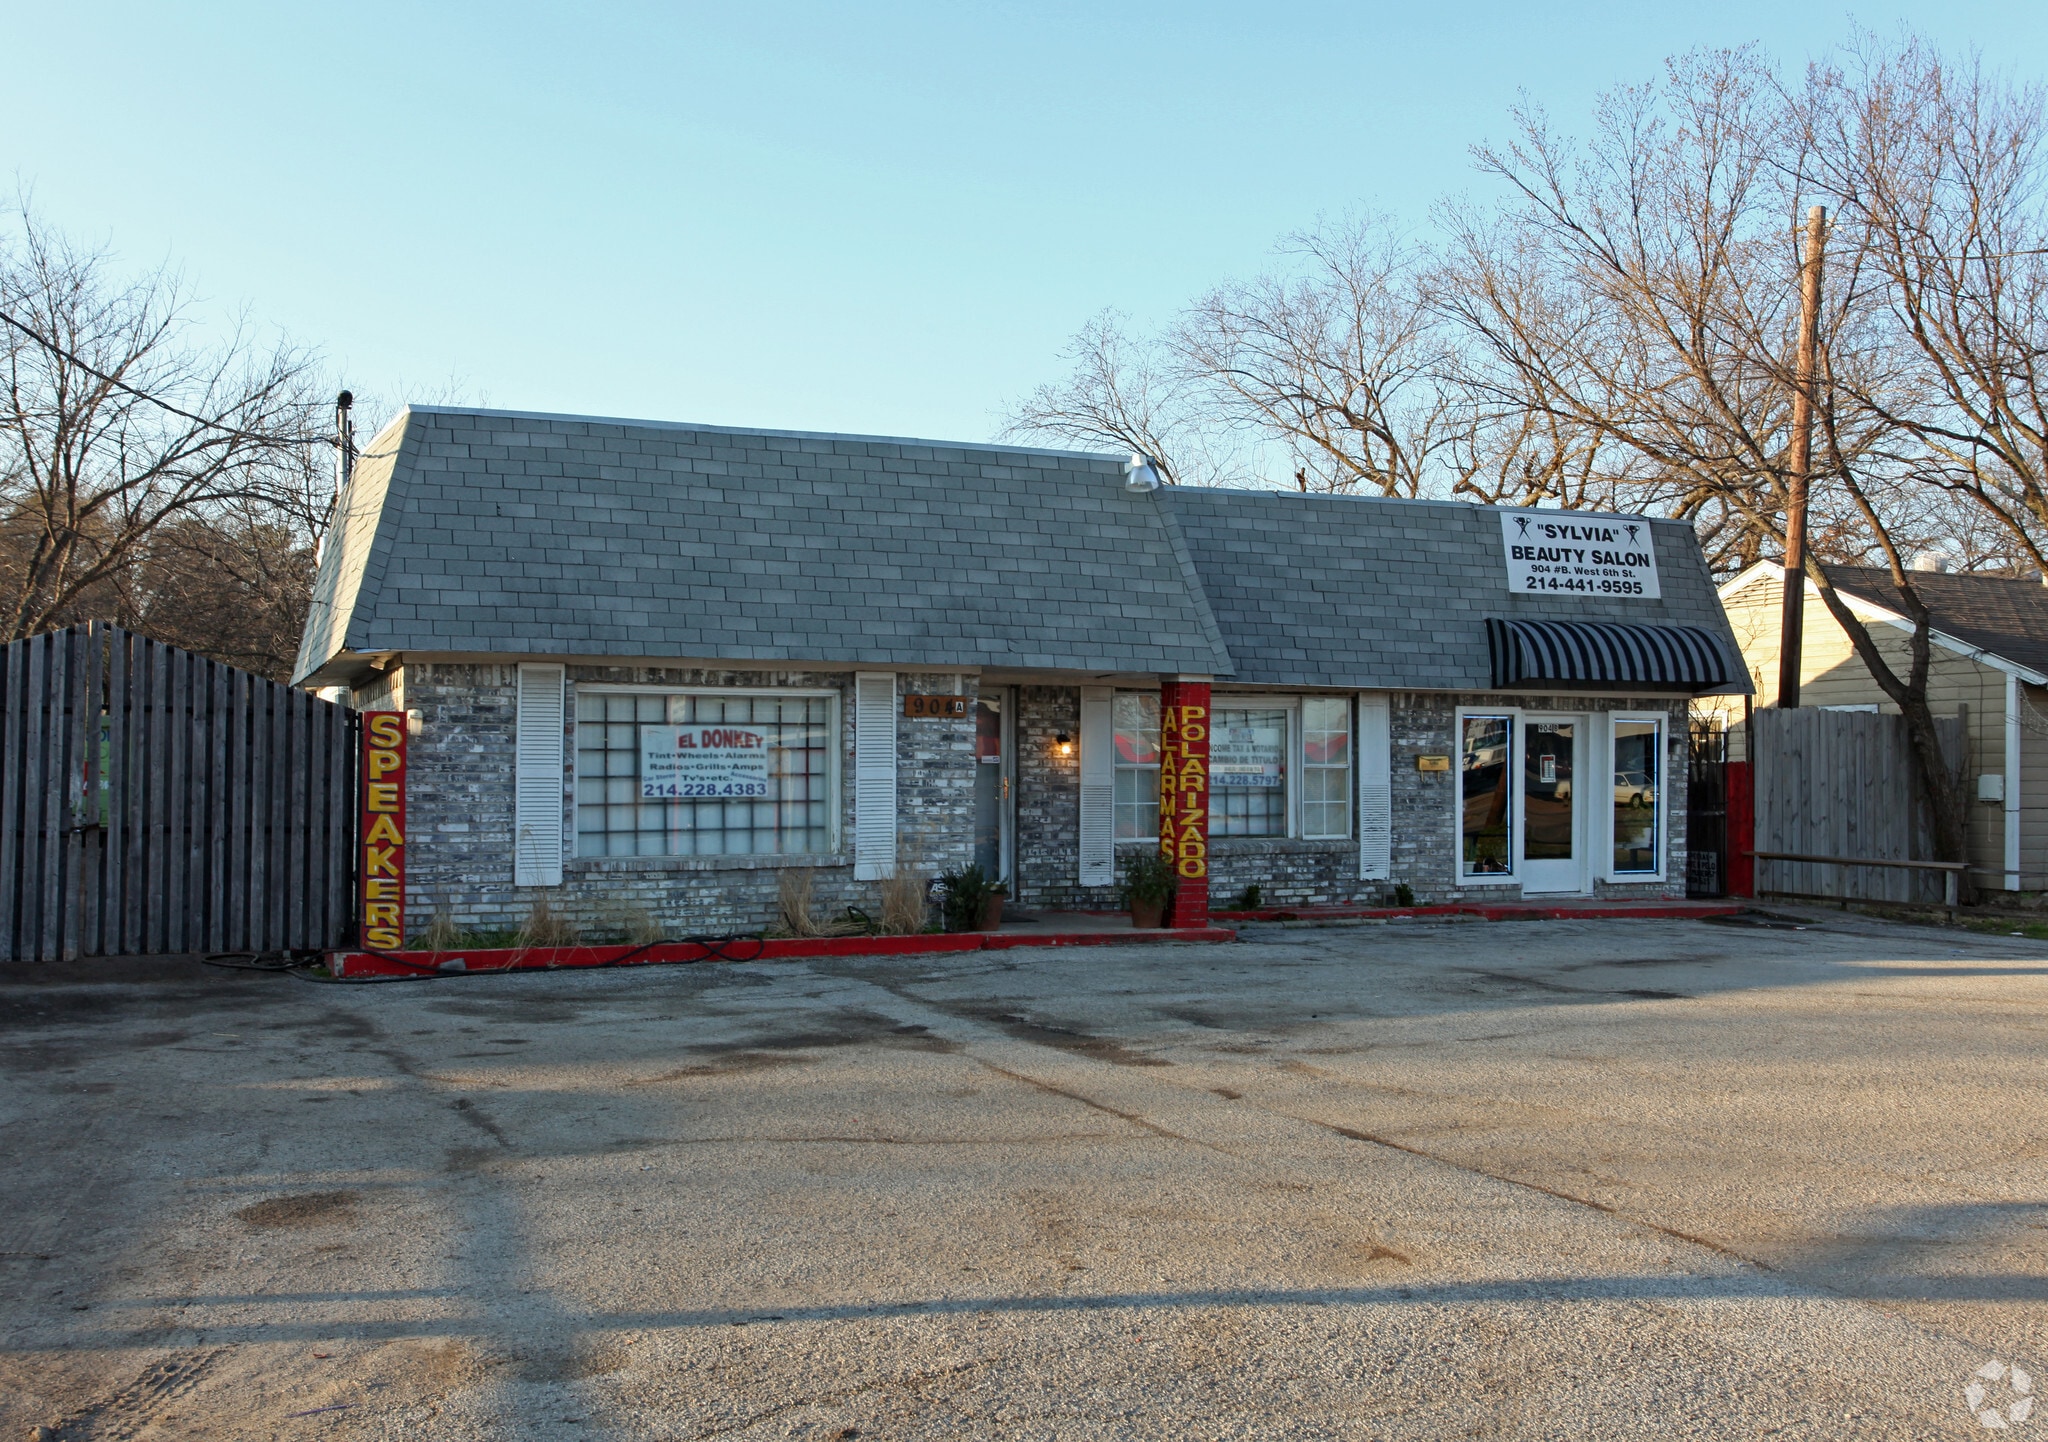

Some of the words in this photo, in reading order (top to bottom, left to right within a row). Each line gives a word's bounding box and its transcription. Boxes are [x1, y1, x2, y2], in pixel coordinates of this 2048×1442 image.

[1537, 523, 1619, 542] "SYLVIA"
[1511, 545, 1585, 563] BEAUTY
[1592, 550, 1650, 567] SALON
[1531, 564, 1550, 573] 904
[1554, 566, 1571, 574] #B.
[1574, 566, 1600, 576] West
[1602, 568, 1619, 577] 6th
[1622, 569, 1636, 578] St.
[1526, 576, 1643, 594] 214-441-9595
[678, 733, 697, 749] EL
[701, 729, 764, 749] DONKEY
[1209, 744, 1231, 753] NCOME
[1232, 744, 1244, 753] TAX
[1241, 755, 1249, 764] DE
[1251, 755, 1278, 764] TITULO
[643, 783, 767, 796] 214.228.4383
[1160, 706, 1178, 865] ALARMAS
[1178, 706, 1206, 878] POLARIZADO
[365, 714, 404, 949] SPEAKERS
